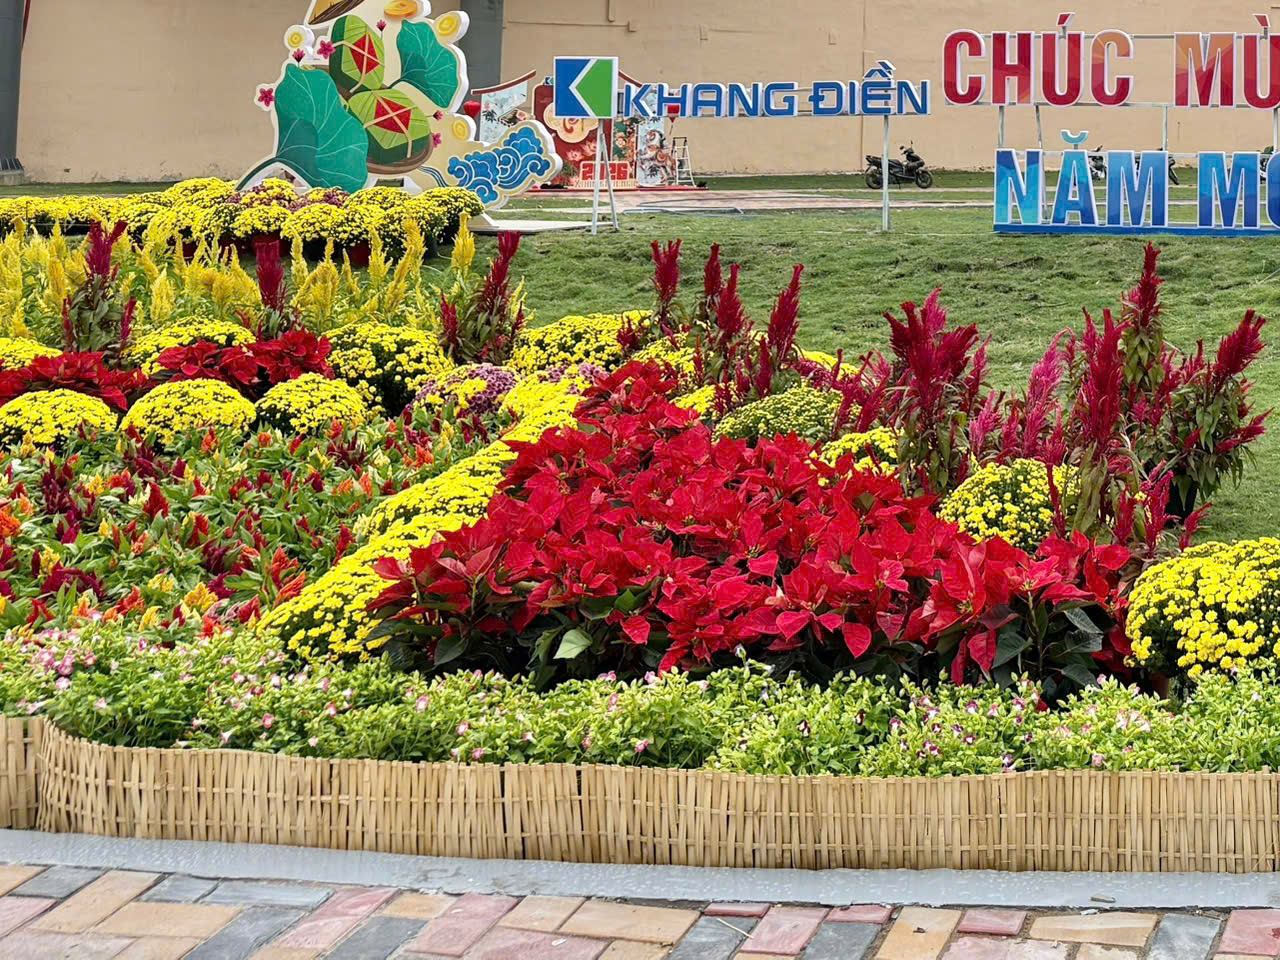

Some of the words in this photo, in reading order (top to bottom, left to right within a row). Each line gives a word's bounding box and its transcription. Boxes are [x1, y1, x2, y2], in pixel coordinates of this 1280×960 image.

[623, 81, 798, 118] KHANG
[808, 60, 931, 117] ĐIỀN
[943, 12, 1134, 107] CHÚC
[993, 129, 1169, 227] NĂM
